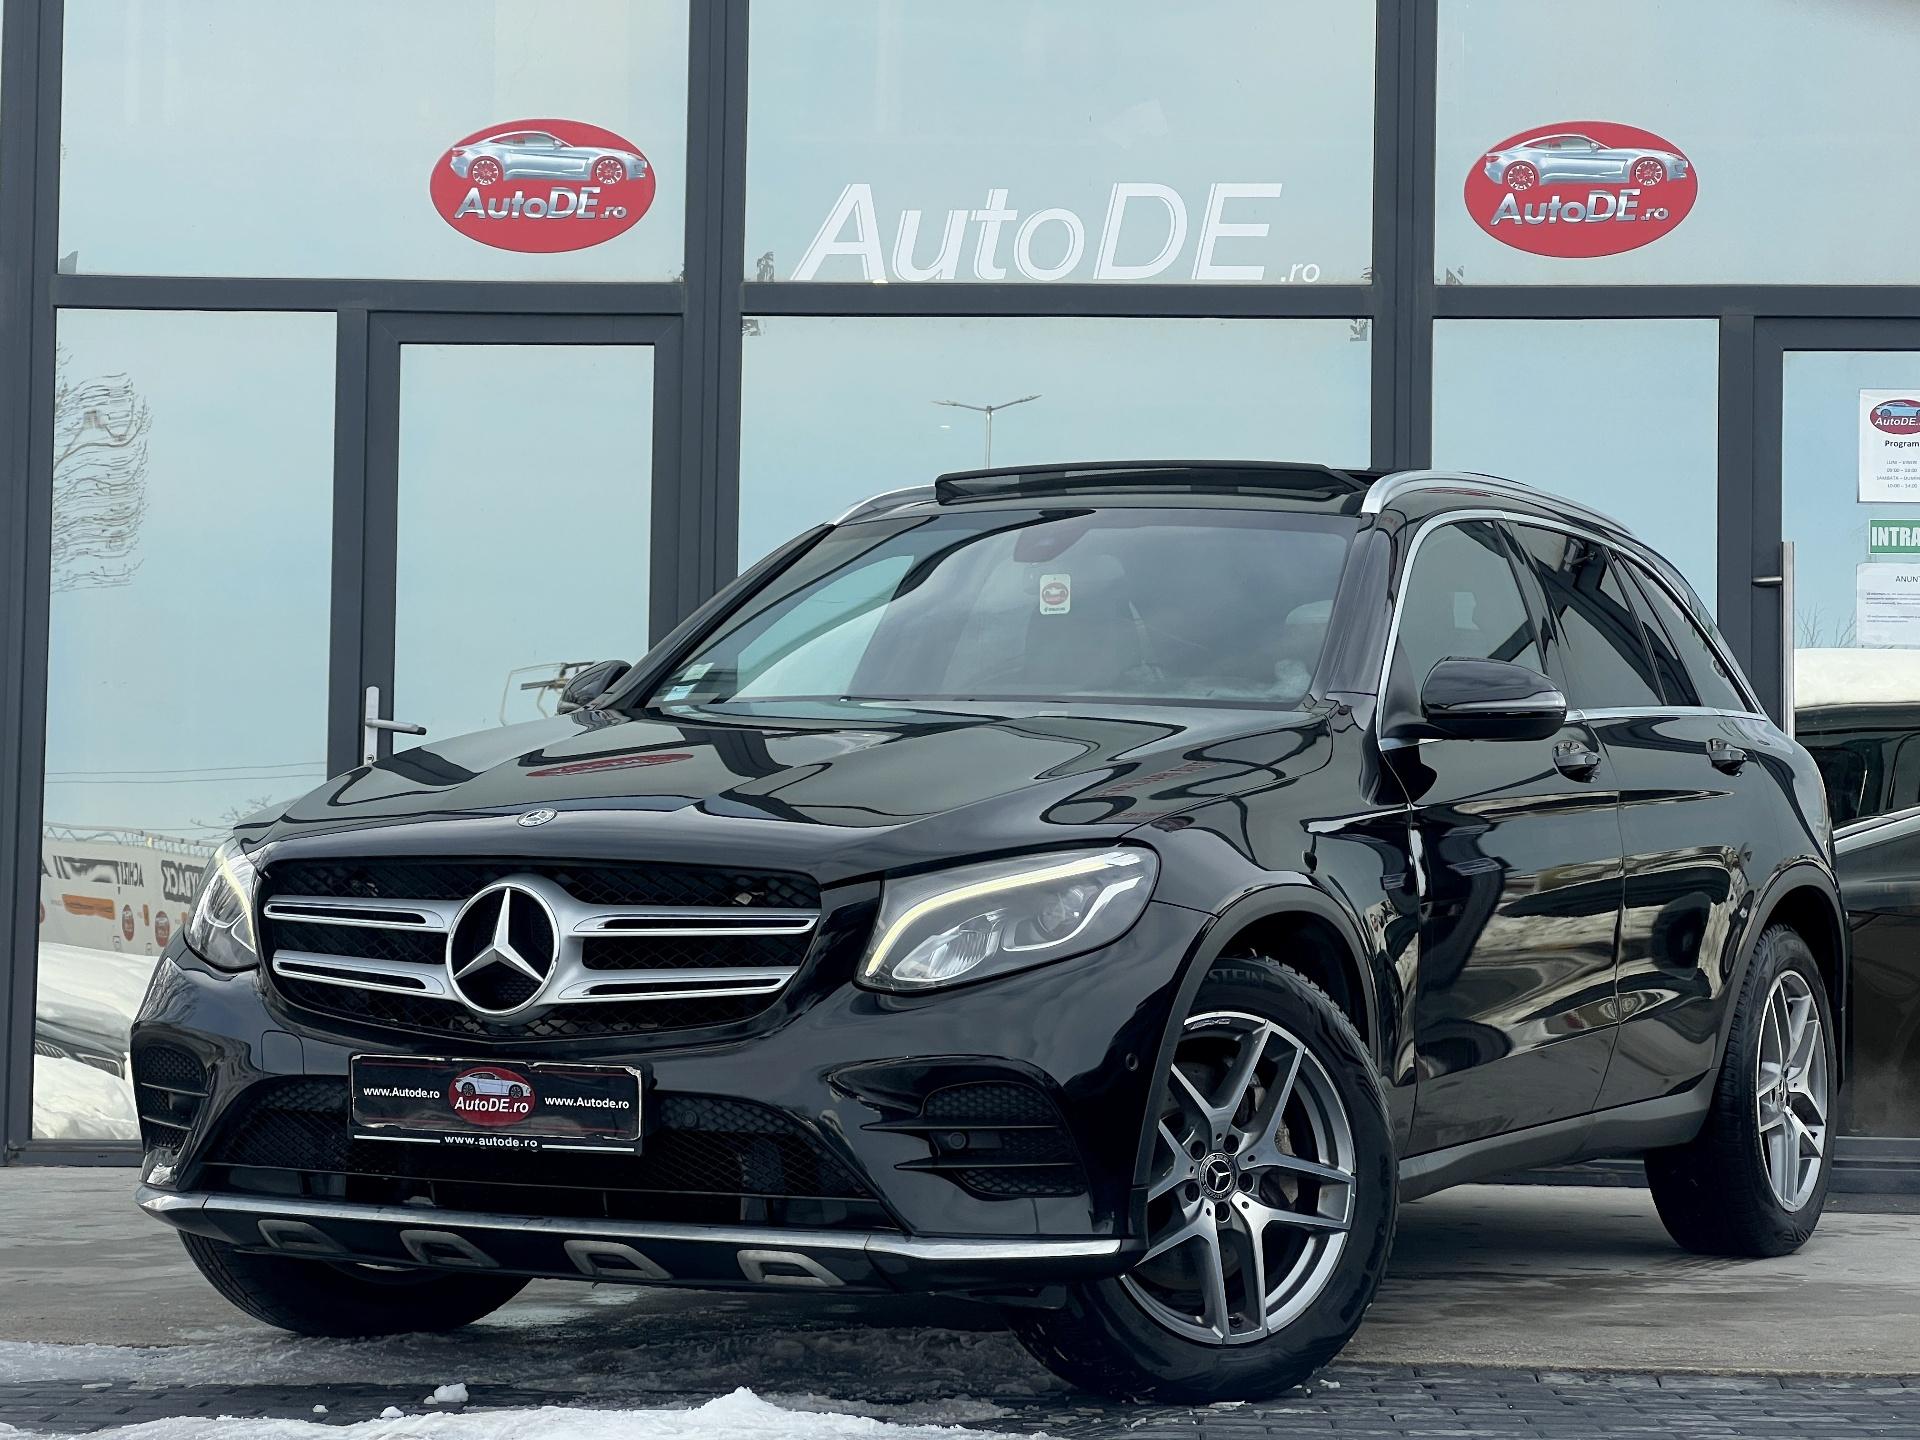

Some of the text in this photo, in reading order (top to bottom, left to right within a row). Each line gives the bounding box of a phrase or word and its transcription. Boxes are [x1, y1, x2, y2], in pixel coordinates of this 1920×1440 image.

[1884, 439, 1920, 449] Program
[363, 1086, 440, 1100] www.Autode.ro
[454, 1096, 529, 1114] AutoDE.ro
[544, 1096, 630, 1110] www.Autode.ro
[444, 1135, 538, 1148] www.autode.ro
